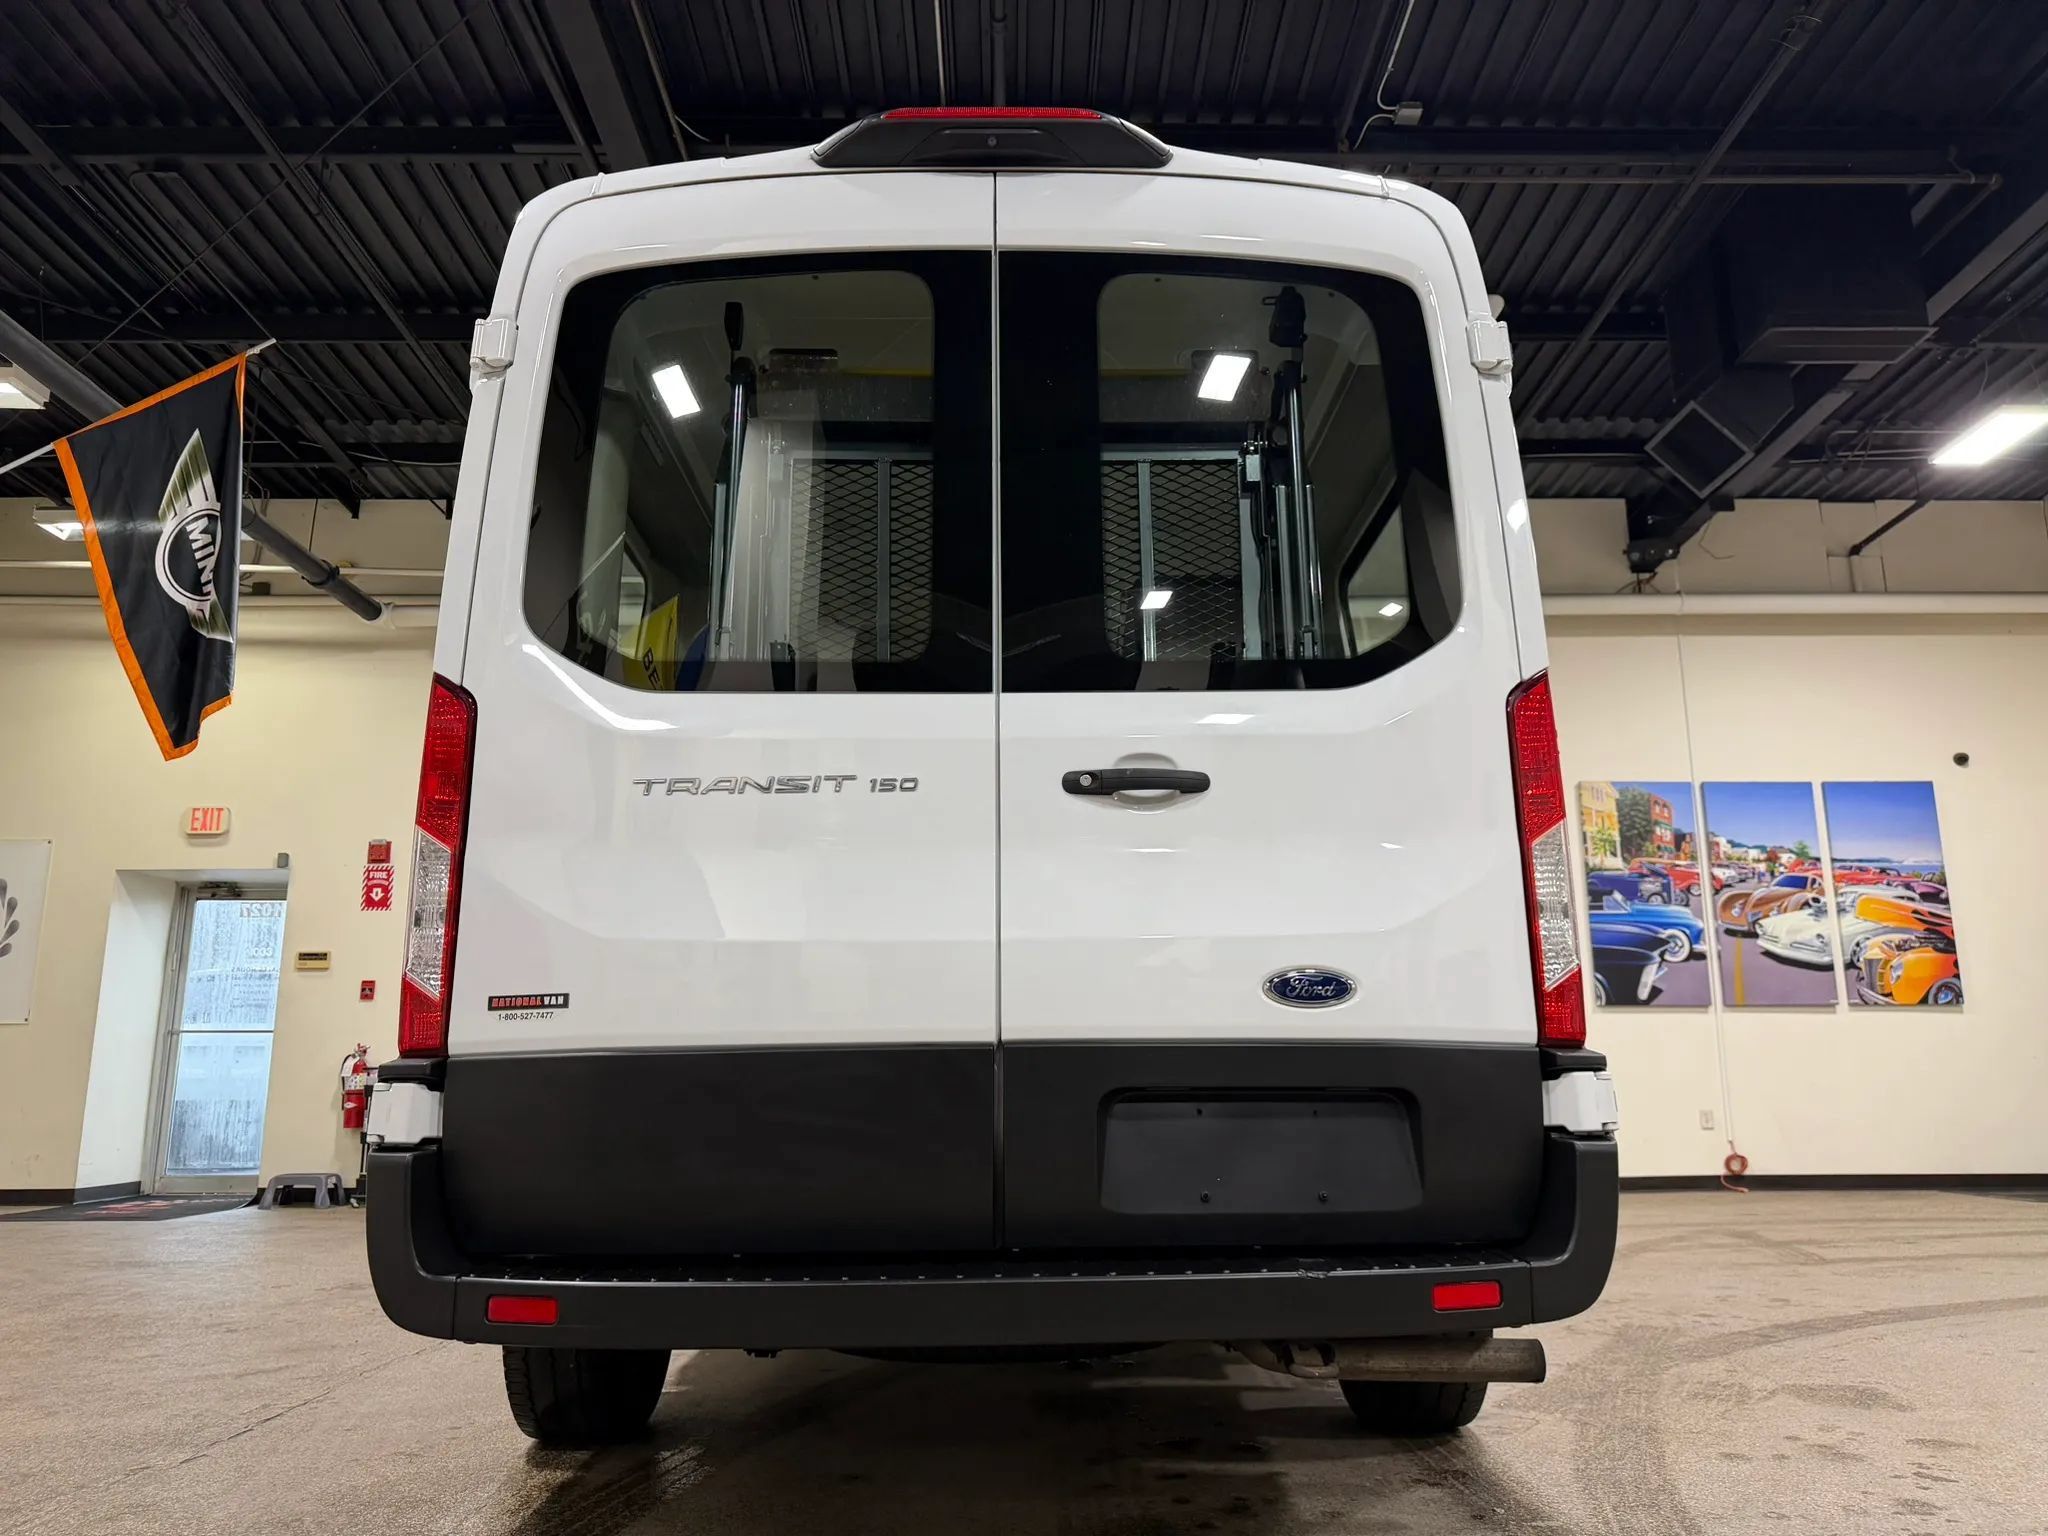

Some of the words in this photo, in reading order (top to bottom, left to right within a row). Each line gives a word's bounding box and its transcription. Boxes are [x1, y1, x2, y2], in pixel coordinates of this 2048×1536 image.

[643, 647, 664, 690] BE
[632, 774, 857, 796] TRANSIT
[869, 777, 919, 793] 150
[191, 807, 224, 832] EXIT
[369, 871, 389, 879] FIRE
[1285, 975, 1337, 998] Ford
[491, 996, 542, 1008] NATIONAL
[543, 995, 564, 1006] VAN
[498, 1011, 554, 1021] 1-800-527-7477
